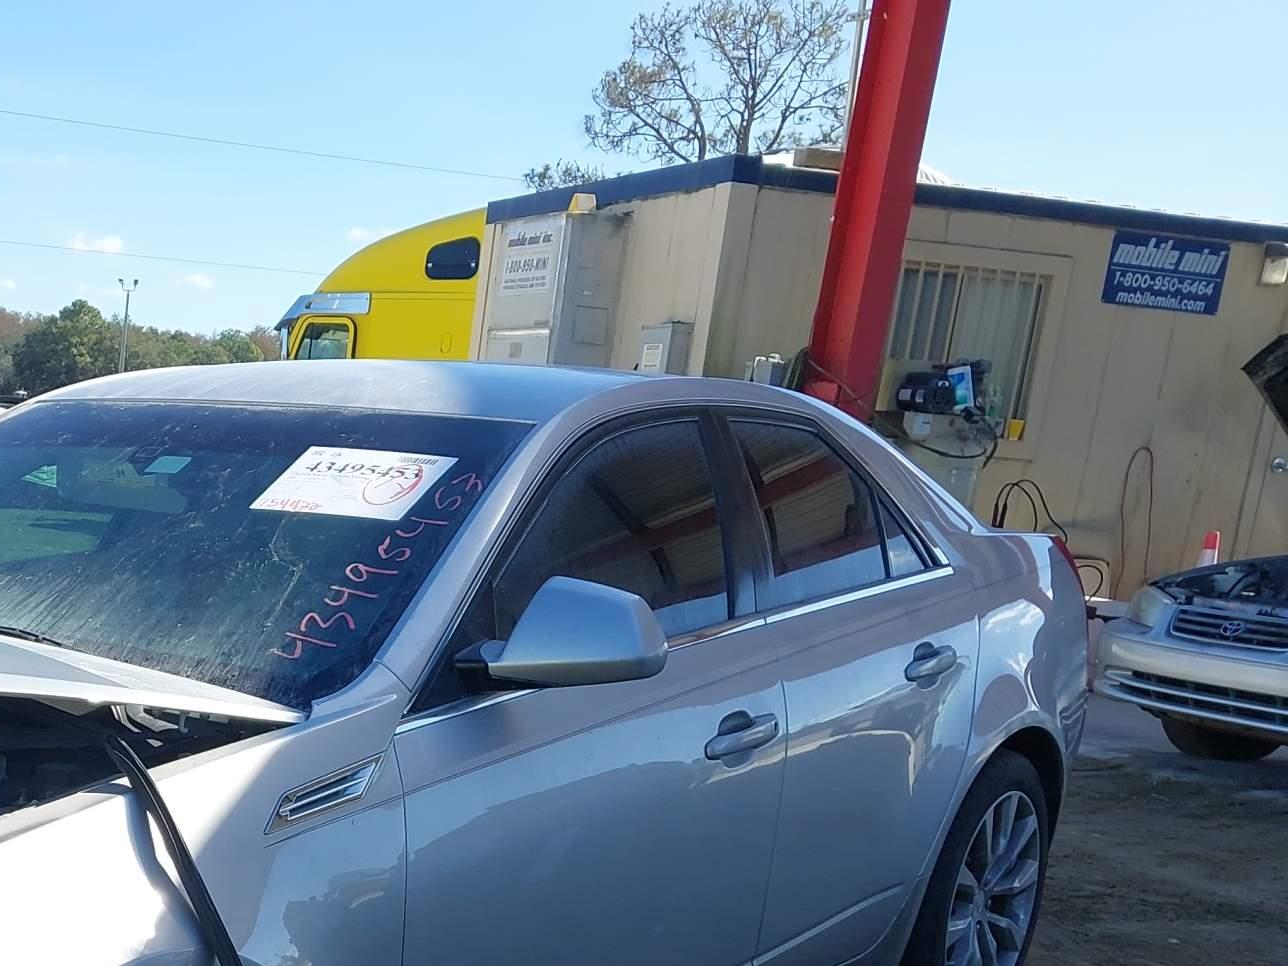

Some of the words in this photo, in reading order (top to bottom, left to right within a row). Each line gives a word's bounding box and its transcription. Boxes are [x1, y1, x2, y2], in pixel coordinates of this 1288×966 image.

[1113, 237, 1180, 270] mobile
[1178, 248, 1228, 275] mini
[1113, 271, 1215, 296] 1-800-950-6464
[1116, 291, 1206, 312] mobilemini.com
[305, 460, 421, 480] 43495453
[270, 472, 484, 659] 43495453
